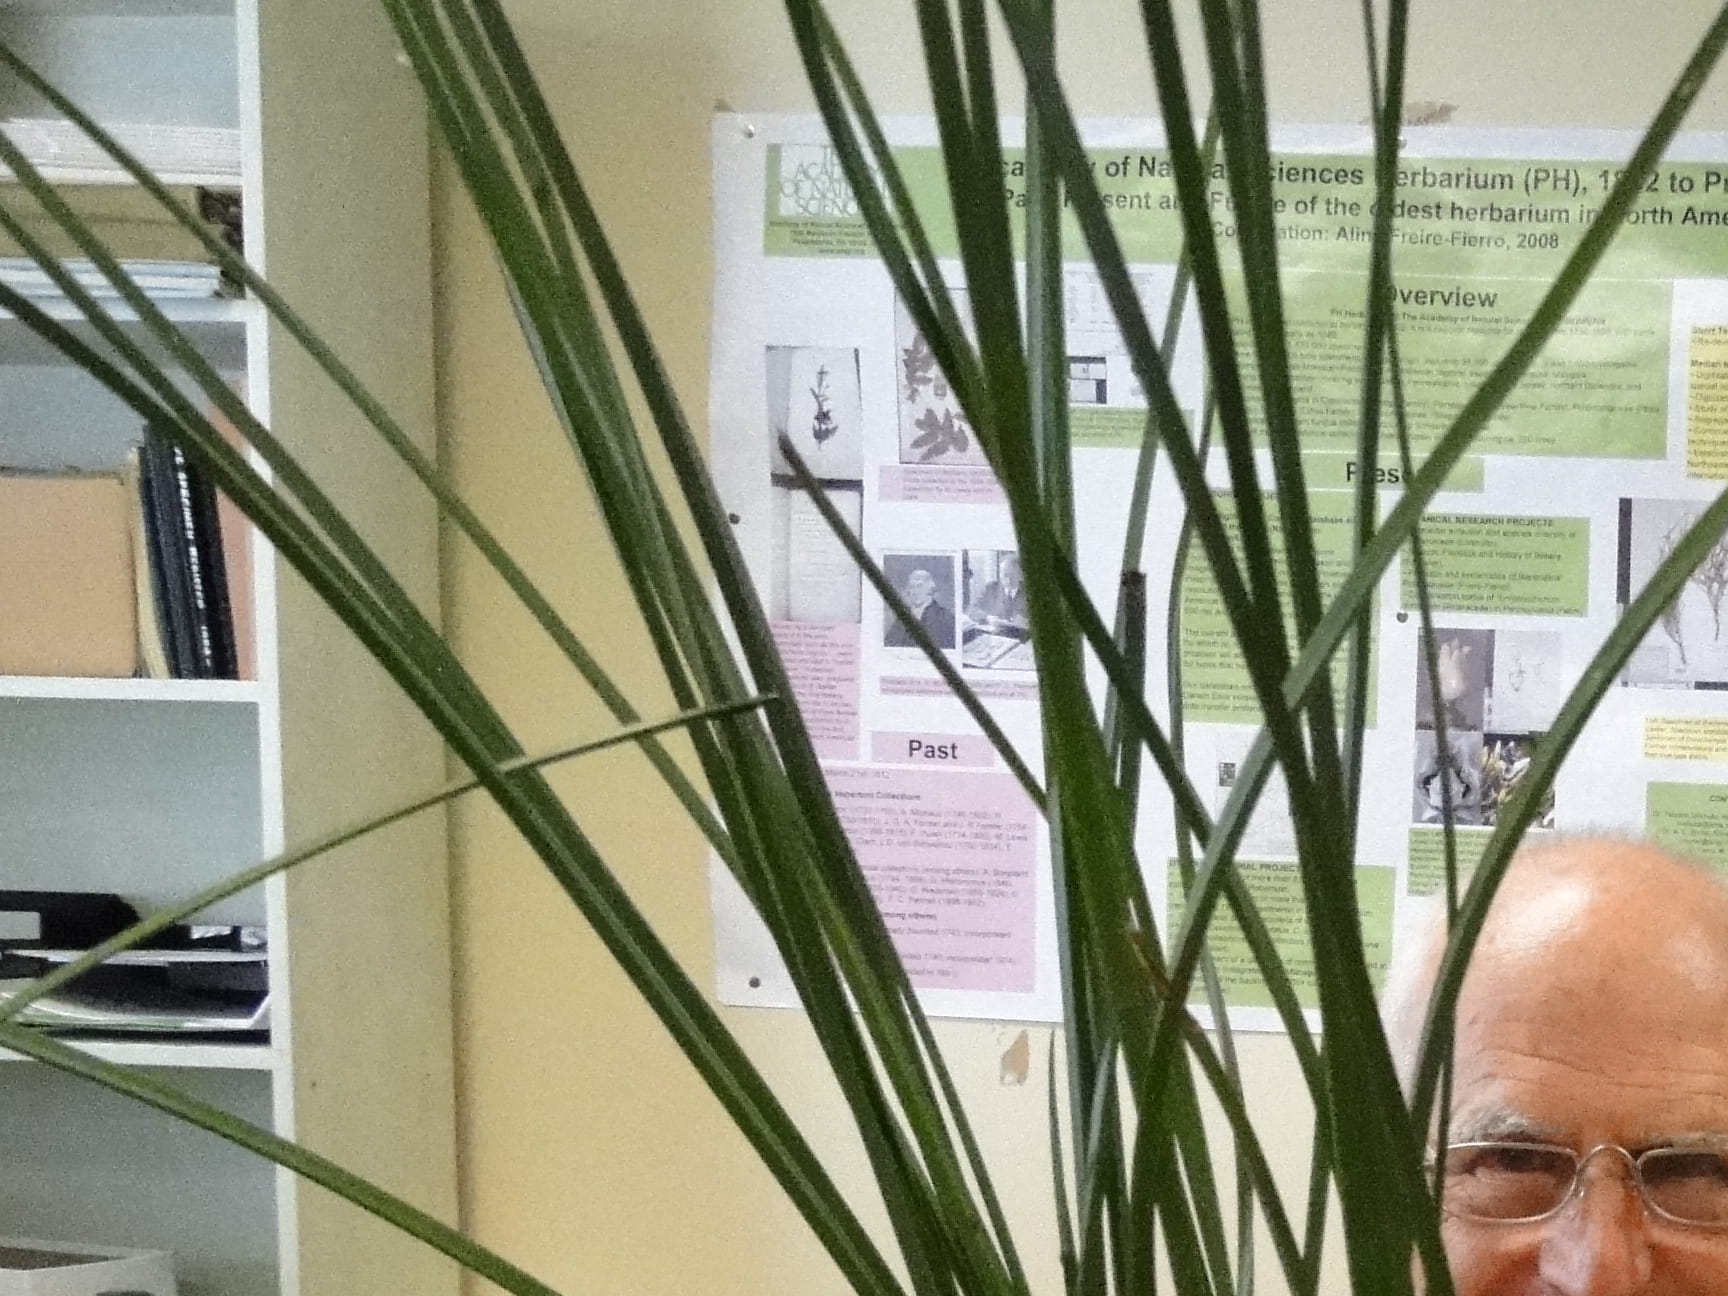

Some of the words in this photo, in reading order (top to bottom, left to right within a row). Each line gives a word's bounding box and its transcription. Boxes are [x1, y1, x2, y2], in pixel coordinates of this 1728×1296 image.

[1105, 155, 1131, 178] of
[1268, 160, 1364, 185] ciences
[1394, 166, 1514, 190] erbarium
[1670, 171, 1694, 193] to
[1294, 196, 1318, 215] of
[1325, 197, 1361, 217] the
[1450, 202, 1570, 225] herbarium
[1627, 206, 1672, 225] orth
[1517, 232, 1559, 249] 2008
[1388, 286, 1498, 309] verview
[1421, 515, 1451, 525] ANICAL
[907, 738, 959, 761] Past
